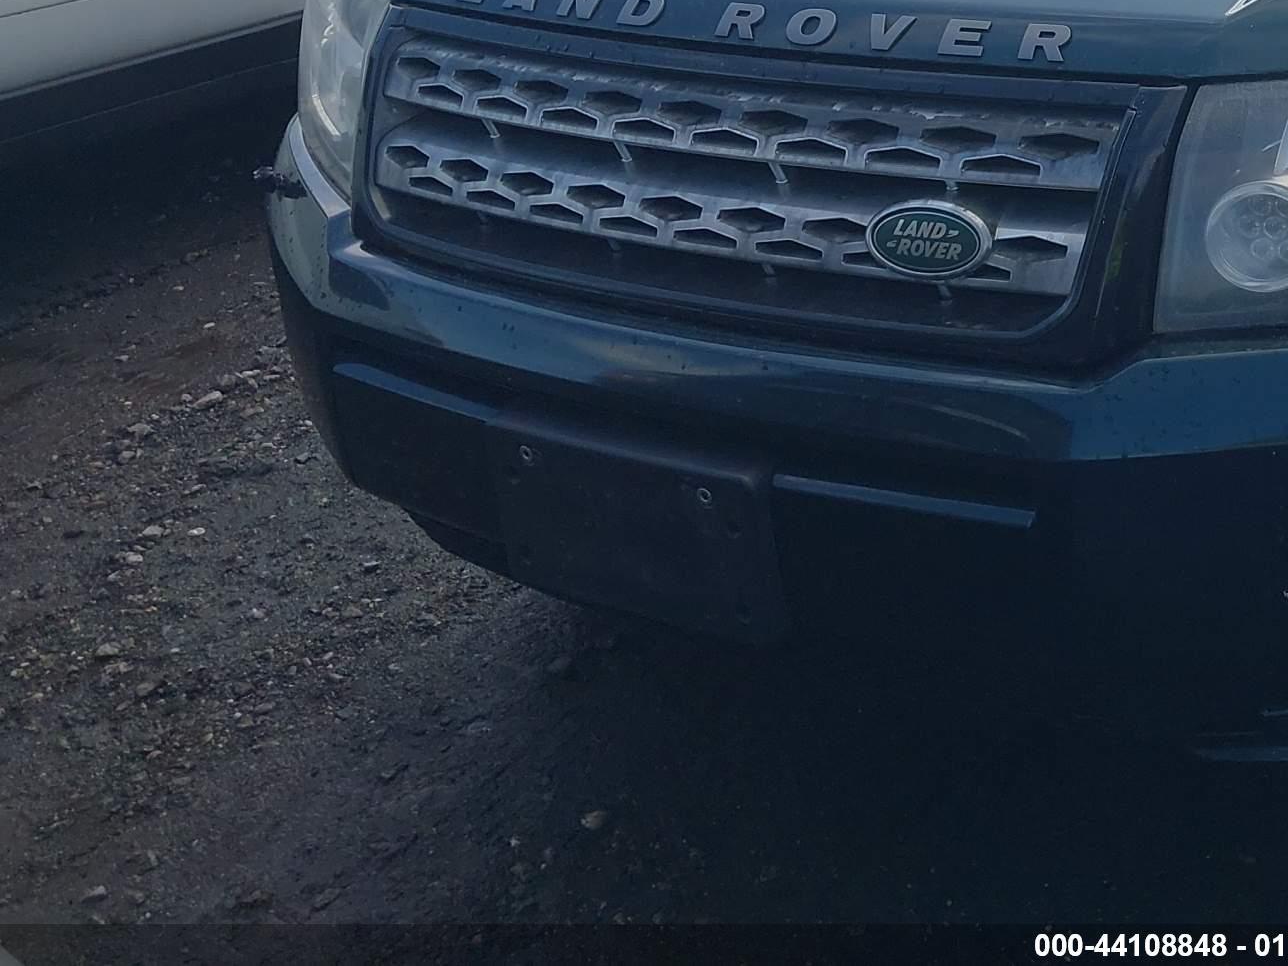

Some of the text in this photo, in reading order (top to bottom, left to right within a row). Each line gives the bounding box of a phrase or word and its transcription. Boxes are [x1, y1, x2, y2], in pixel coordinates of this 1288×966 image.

[714, 1, 1073, 63] ROVER
[893, 218, 948, 239] LAND
[895, 238, 962, 261] ROVER
